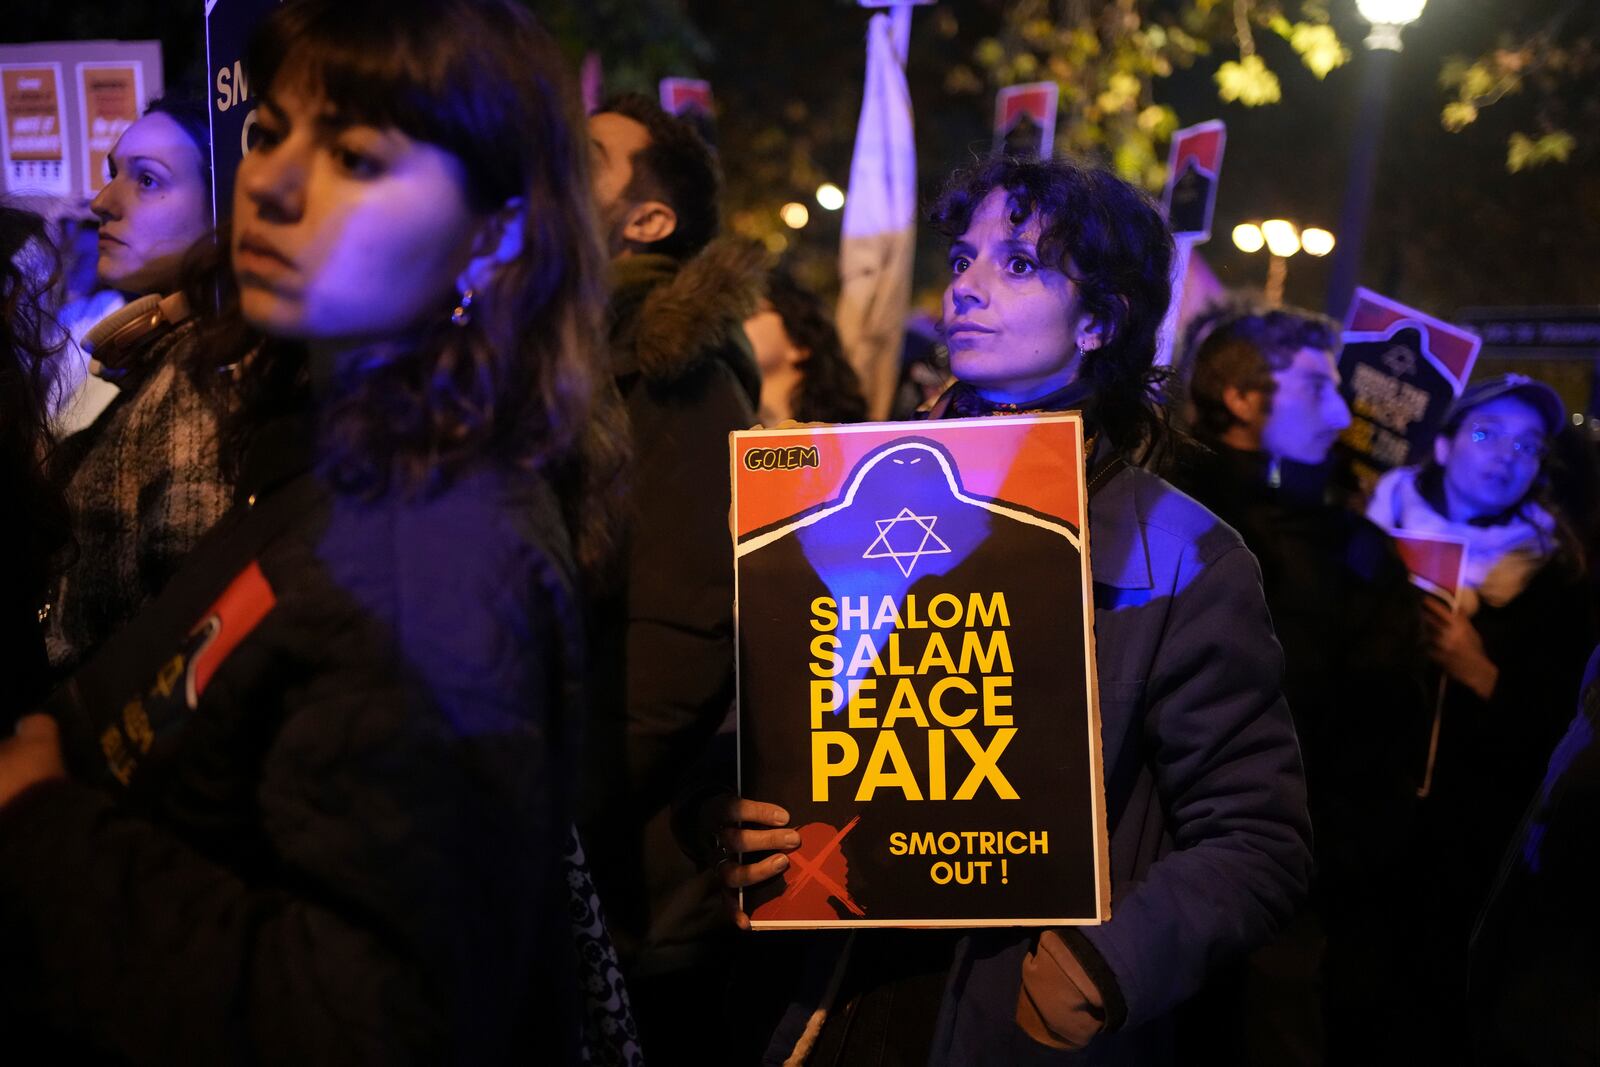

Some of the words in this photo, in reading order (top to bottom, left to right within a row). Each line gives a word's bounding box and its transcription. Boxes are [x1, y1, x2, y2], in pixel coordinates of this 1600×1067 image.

[747, 449, 818, 469] GOLEM
[809, 592, 1011, 632] SHALOM
[808, 630, 1014, 678] SALAM
[809, 676, 1014, 729] PEACE
[811, 727, 1021, 802] PAIX
[889, 830, 1049, 856] SMOTRICH
[930, 861, 992, 885] OUT
